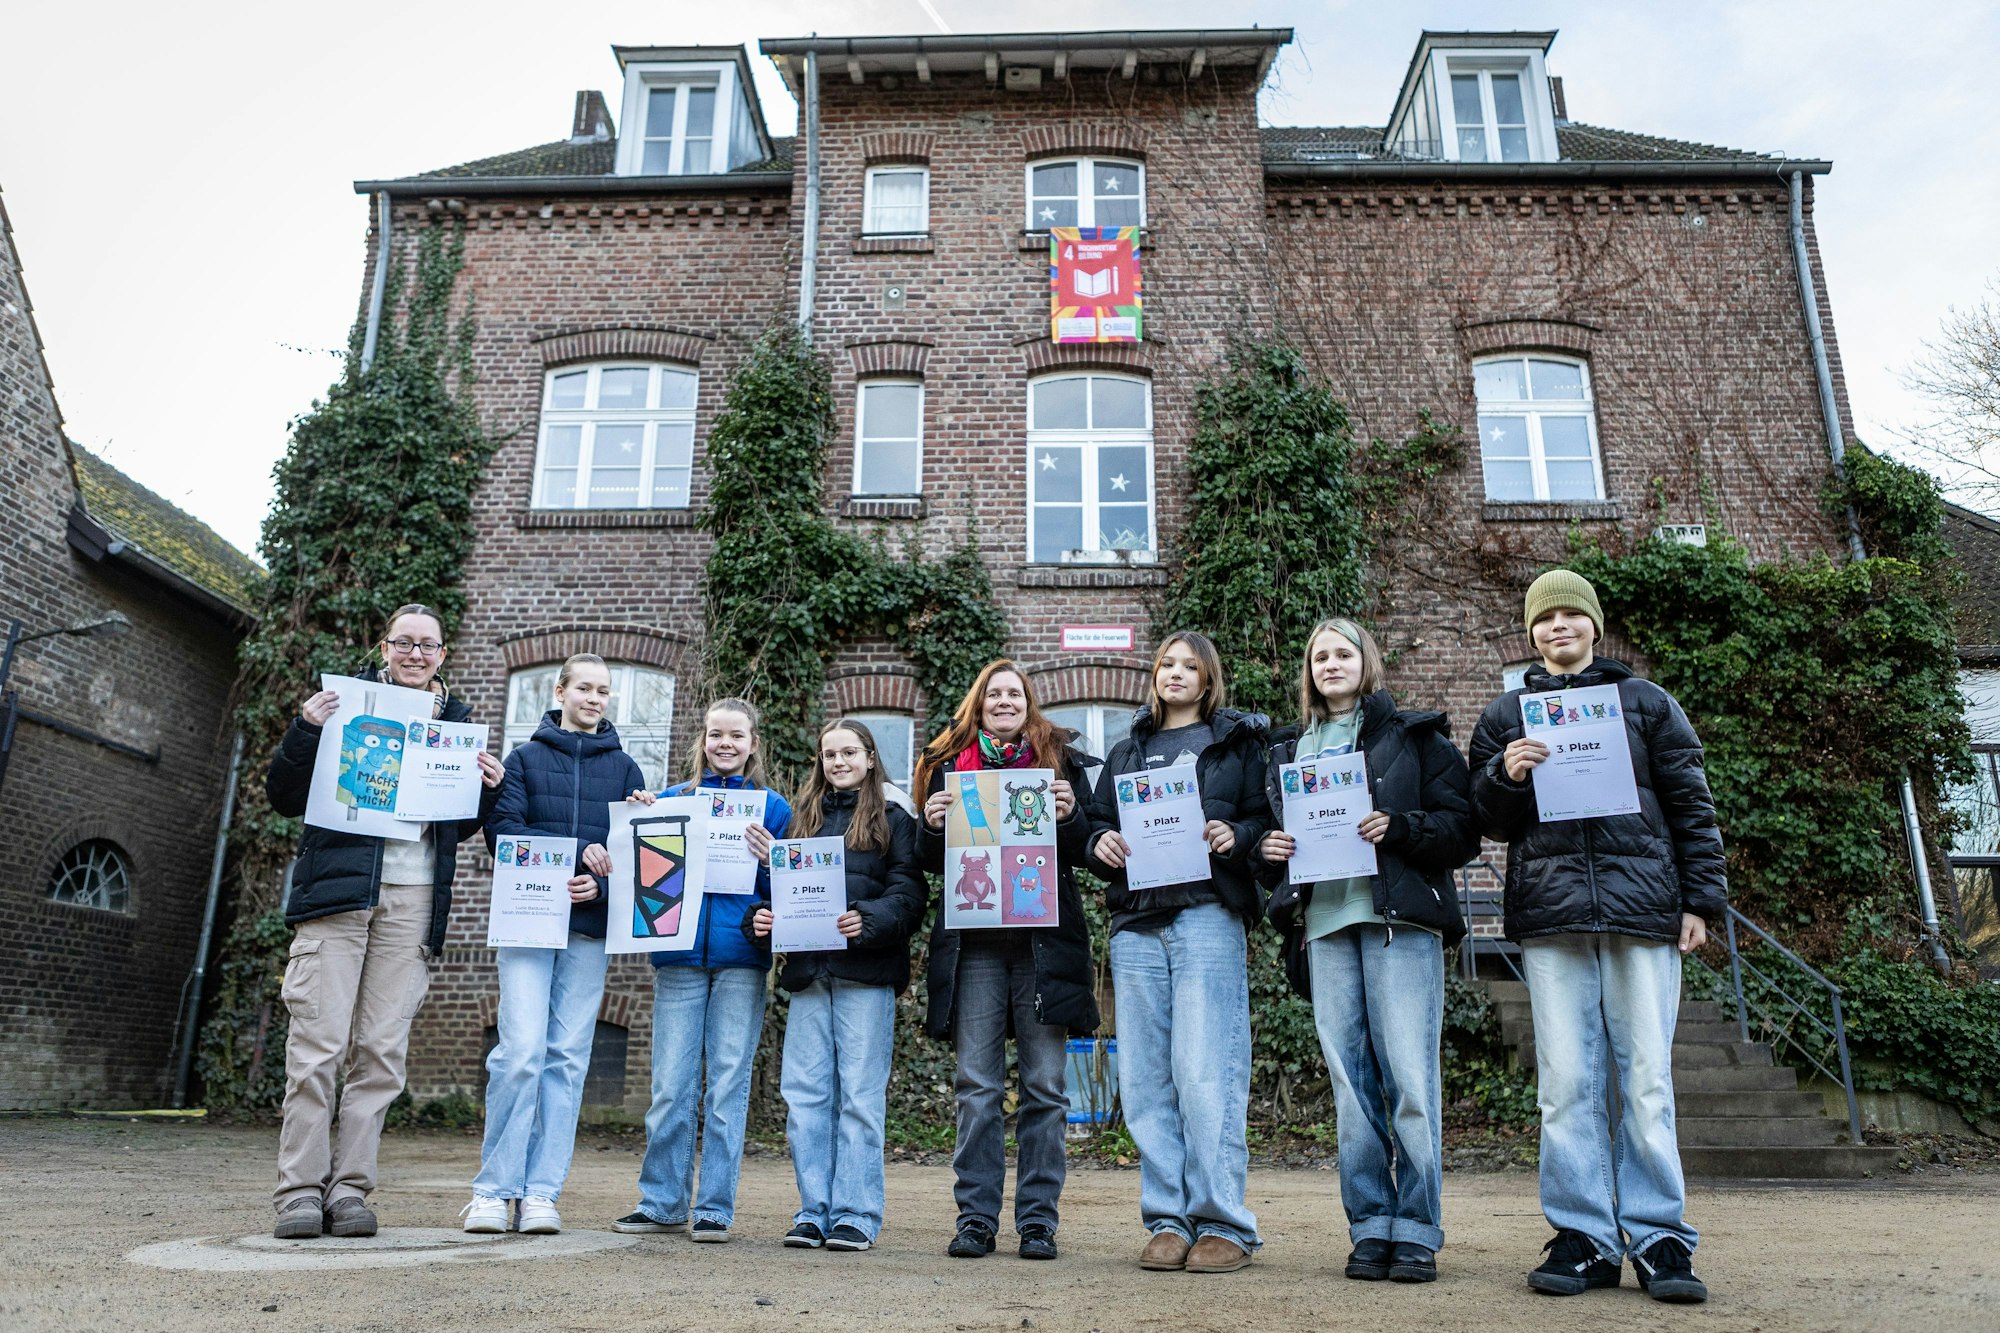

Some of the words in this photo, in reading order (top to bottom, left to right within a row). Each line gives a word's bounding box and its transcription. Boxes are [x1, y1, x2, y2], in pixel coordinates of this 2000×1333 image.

[1064, 244, 1074, 260] 4
[1569, 742, 1601, 752] Platz
[357, 770, 399, 788] MACH'S
[366, 786, 388, 797] FÜR
[356, 795, 391, 809] MICH!
[1319, 808, 1346, 818] Platz
[1154, 816, 1180, 826] Platz
[526, 883, 552, 892] Platz
